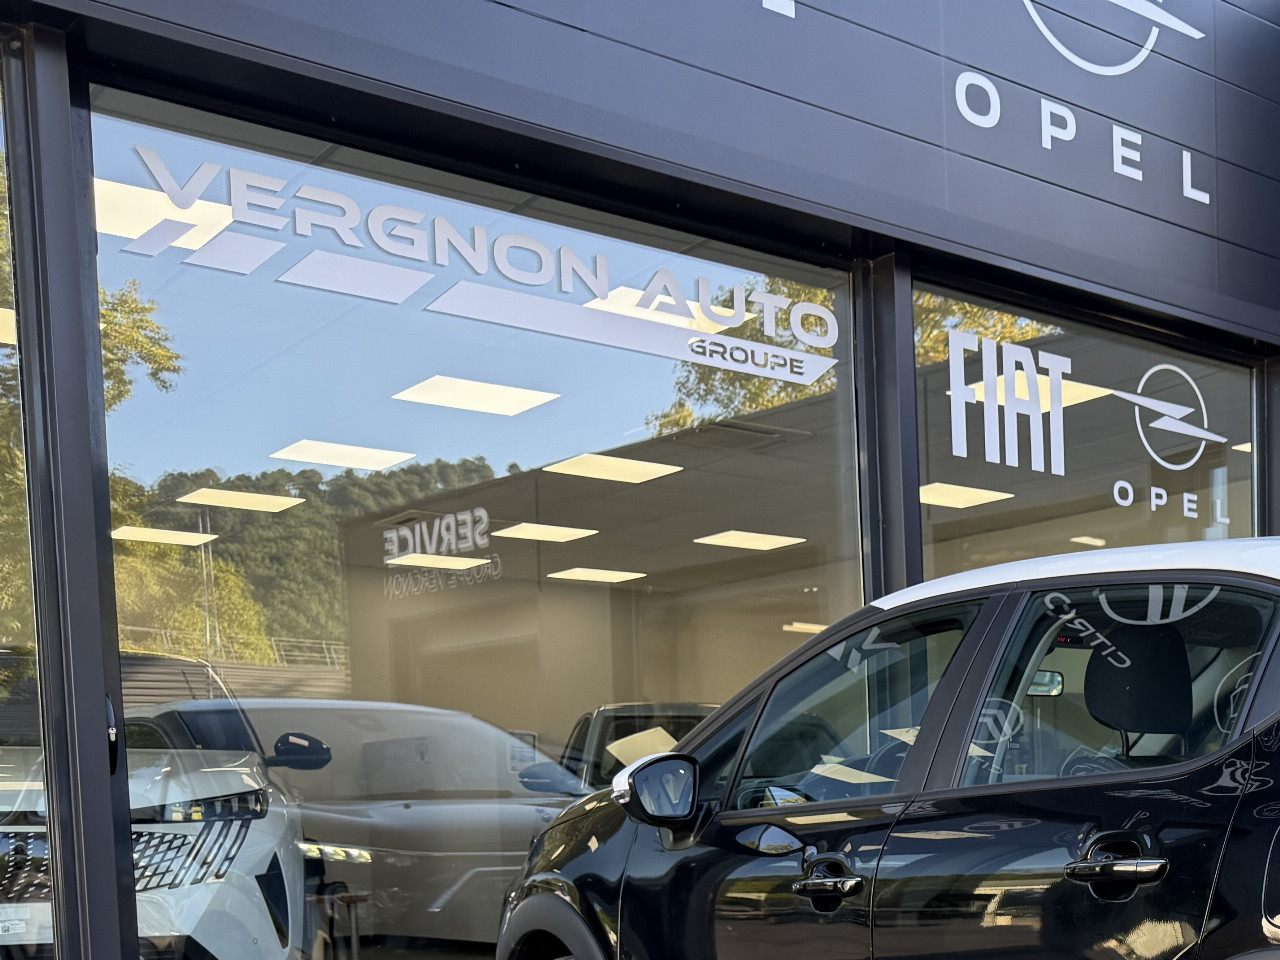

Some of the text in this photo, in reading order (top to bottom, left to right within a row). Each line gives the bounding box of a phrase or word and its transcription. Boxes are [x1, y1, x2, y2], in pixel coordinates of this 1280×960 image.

[955, 71, 1210, 204] OPEL
[134, 145, 839, 348] VERGNON AUTO
[688, 338, 805, 377] GROUPE
[949, 329, 1072, 476] FIAT
[1113, 480, 1230, 524] OPEL
